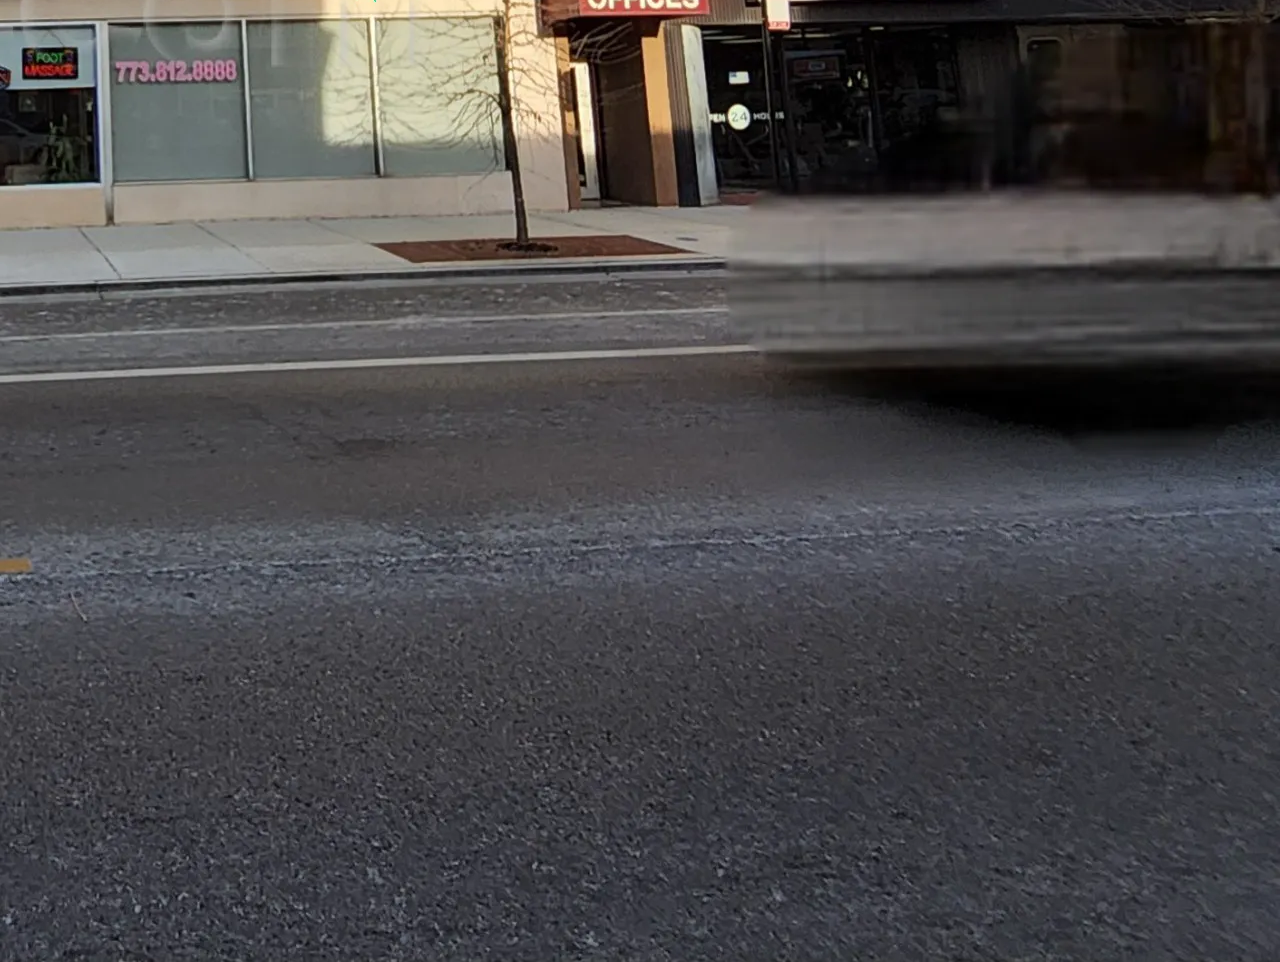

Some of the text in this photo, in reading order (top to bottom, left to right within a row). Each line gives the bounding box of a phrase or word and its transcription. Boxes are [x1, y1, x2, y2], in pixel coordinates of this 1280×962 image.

[35, 51, 65, 63] FOOT
[24, 63, 76, 77] MASSAGE
[115, 59, 238, 83] 773.812.8888
[731, 111, 747, 123] 24
